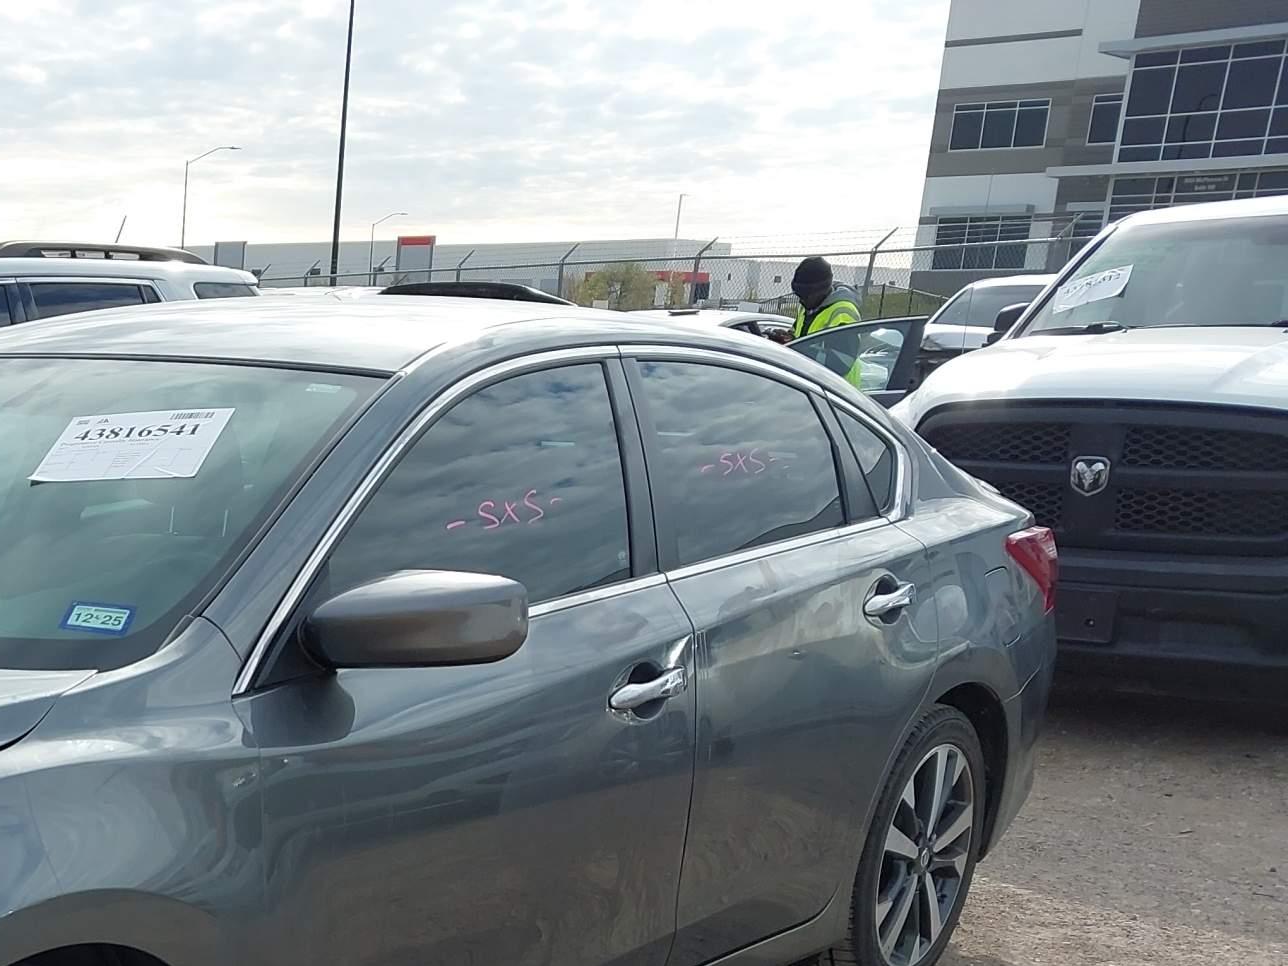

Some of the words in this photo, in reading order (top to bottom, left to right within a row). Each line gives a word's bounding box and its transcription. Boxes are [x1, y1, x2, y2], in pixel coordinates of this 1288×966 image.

[74, 423, 200, 441] 43816541
[74, 612, 93, 624] 12
[100, 615, 123, 627] 25
